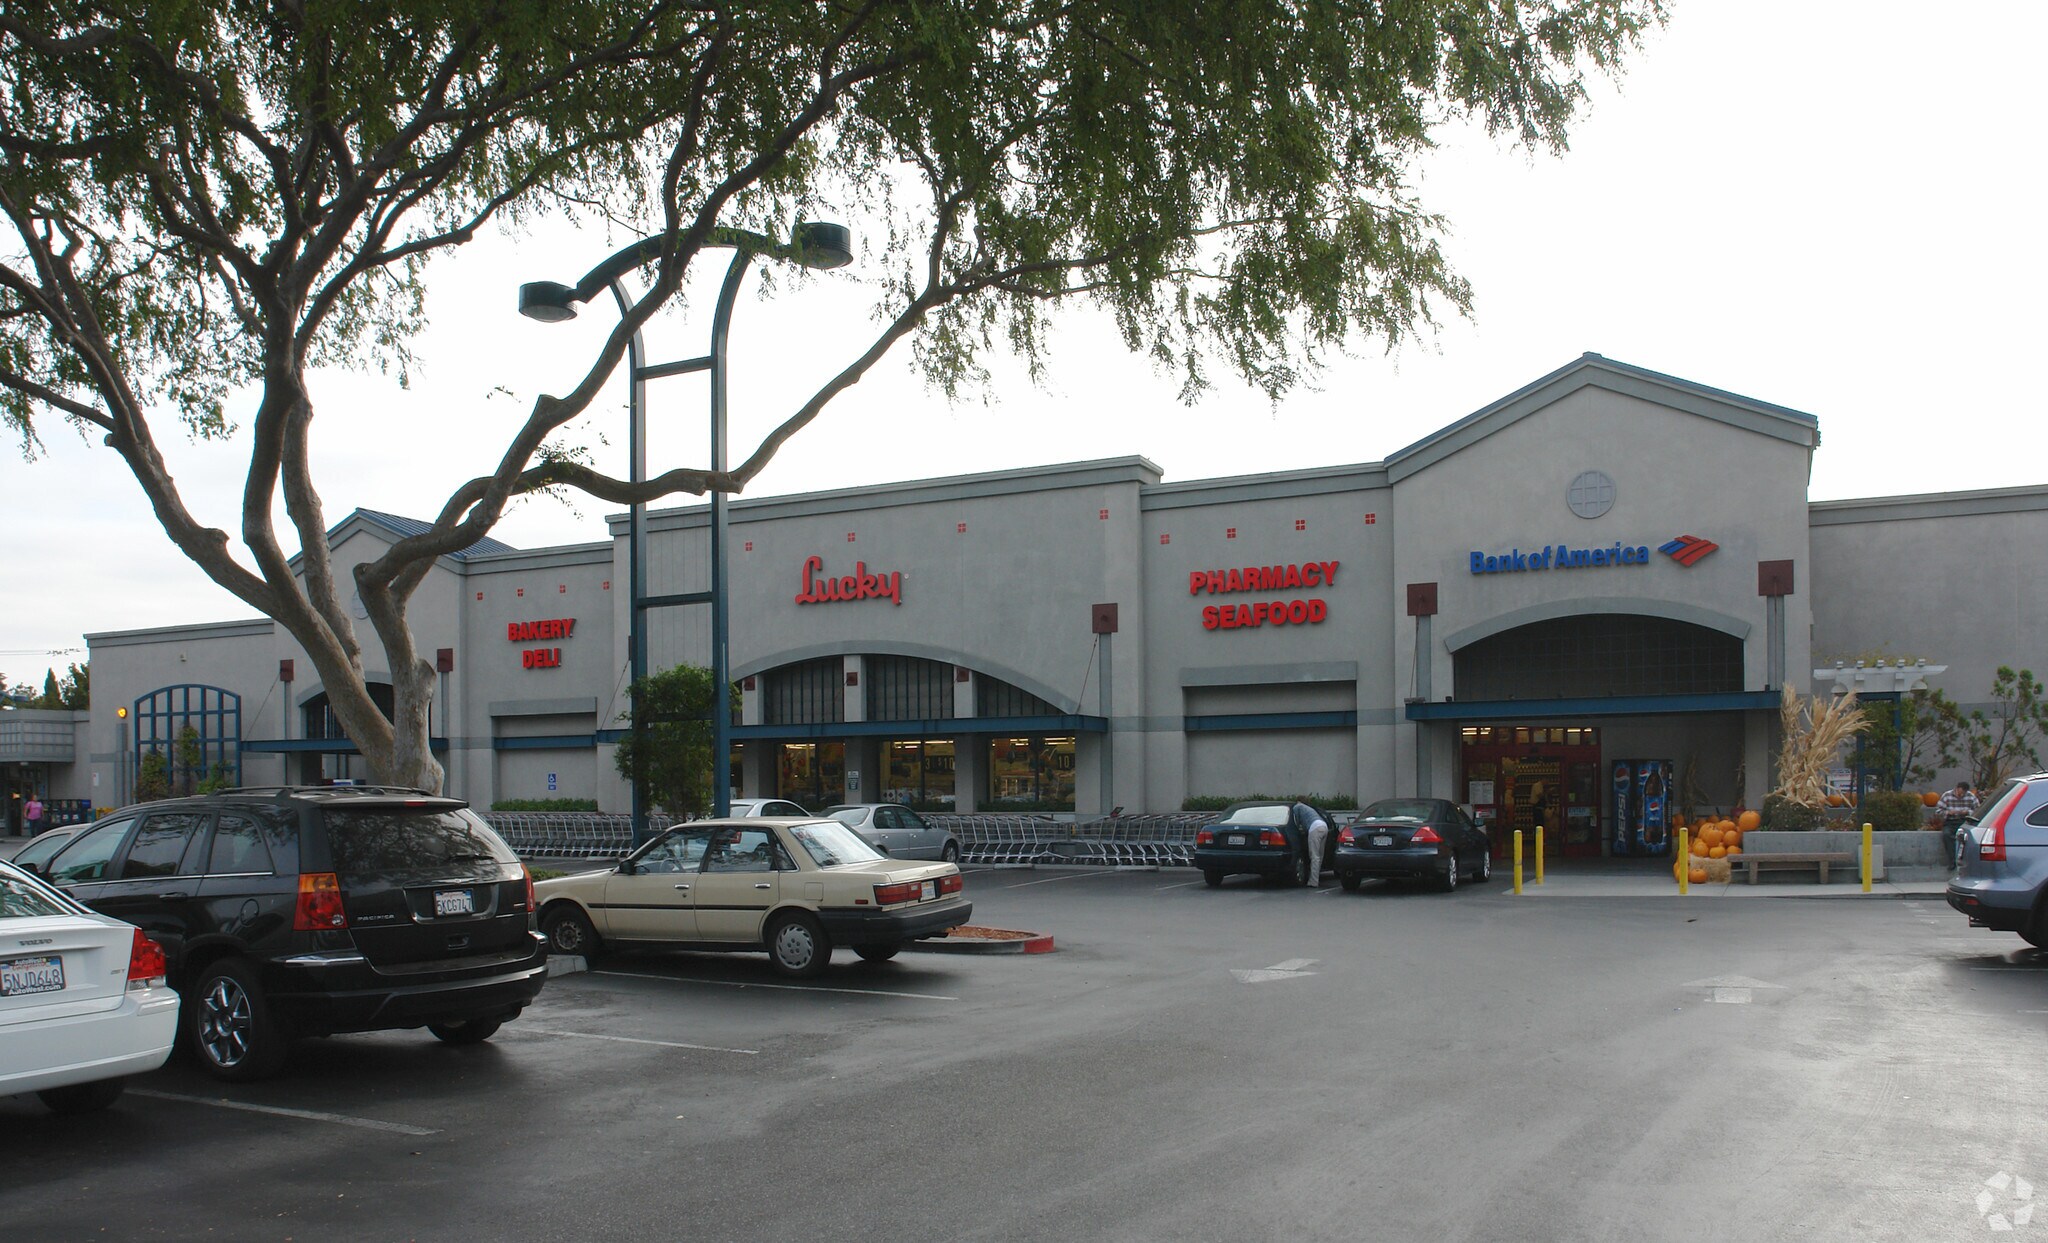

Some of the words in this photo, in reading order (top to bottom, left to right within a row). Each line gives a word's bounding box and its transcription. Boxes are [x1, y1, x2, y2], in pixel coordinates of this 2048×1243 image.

[1470, 549, 1527, 574] Bank
[1528, 545, 1552, 569] of
[1554, 541, 1649, 568] America
[795, 555, 901, 605] Lucky
[1189, 561, 1340, 595] PHARMACY
[1202, 599, 1328, 631] SEAFOOD
[507, 618, 576, 641] BAKERY
[522, 648, 561, 669] DELI
[1618, 793, 1626, 842] PEPSI
[19, 938, 53, 946] VOLVO
[3, 968, 61, 992] 5NJD648
[8, 984, 61, 995] AutoWest.com
